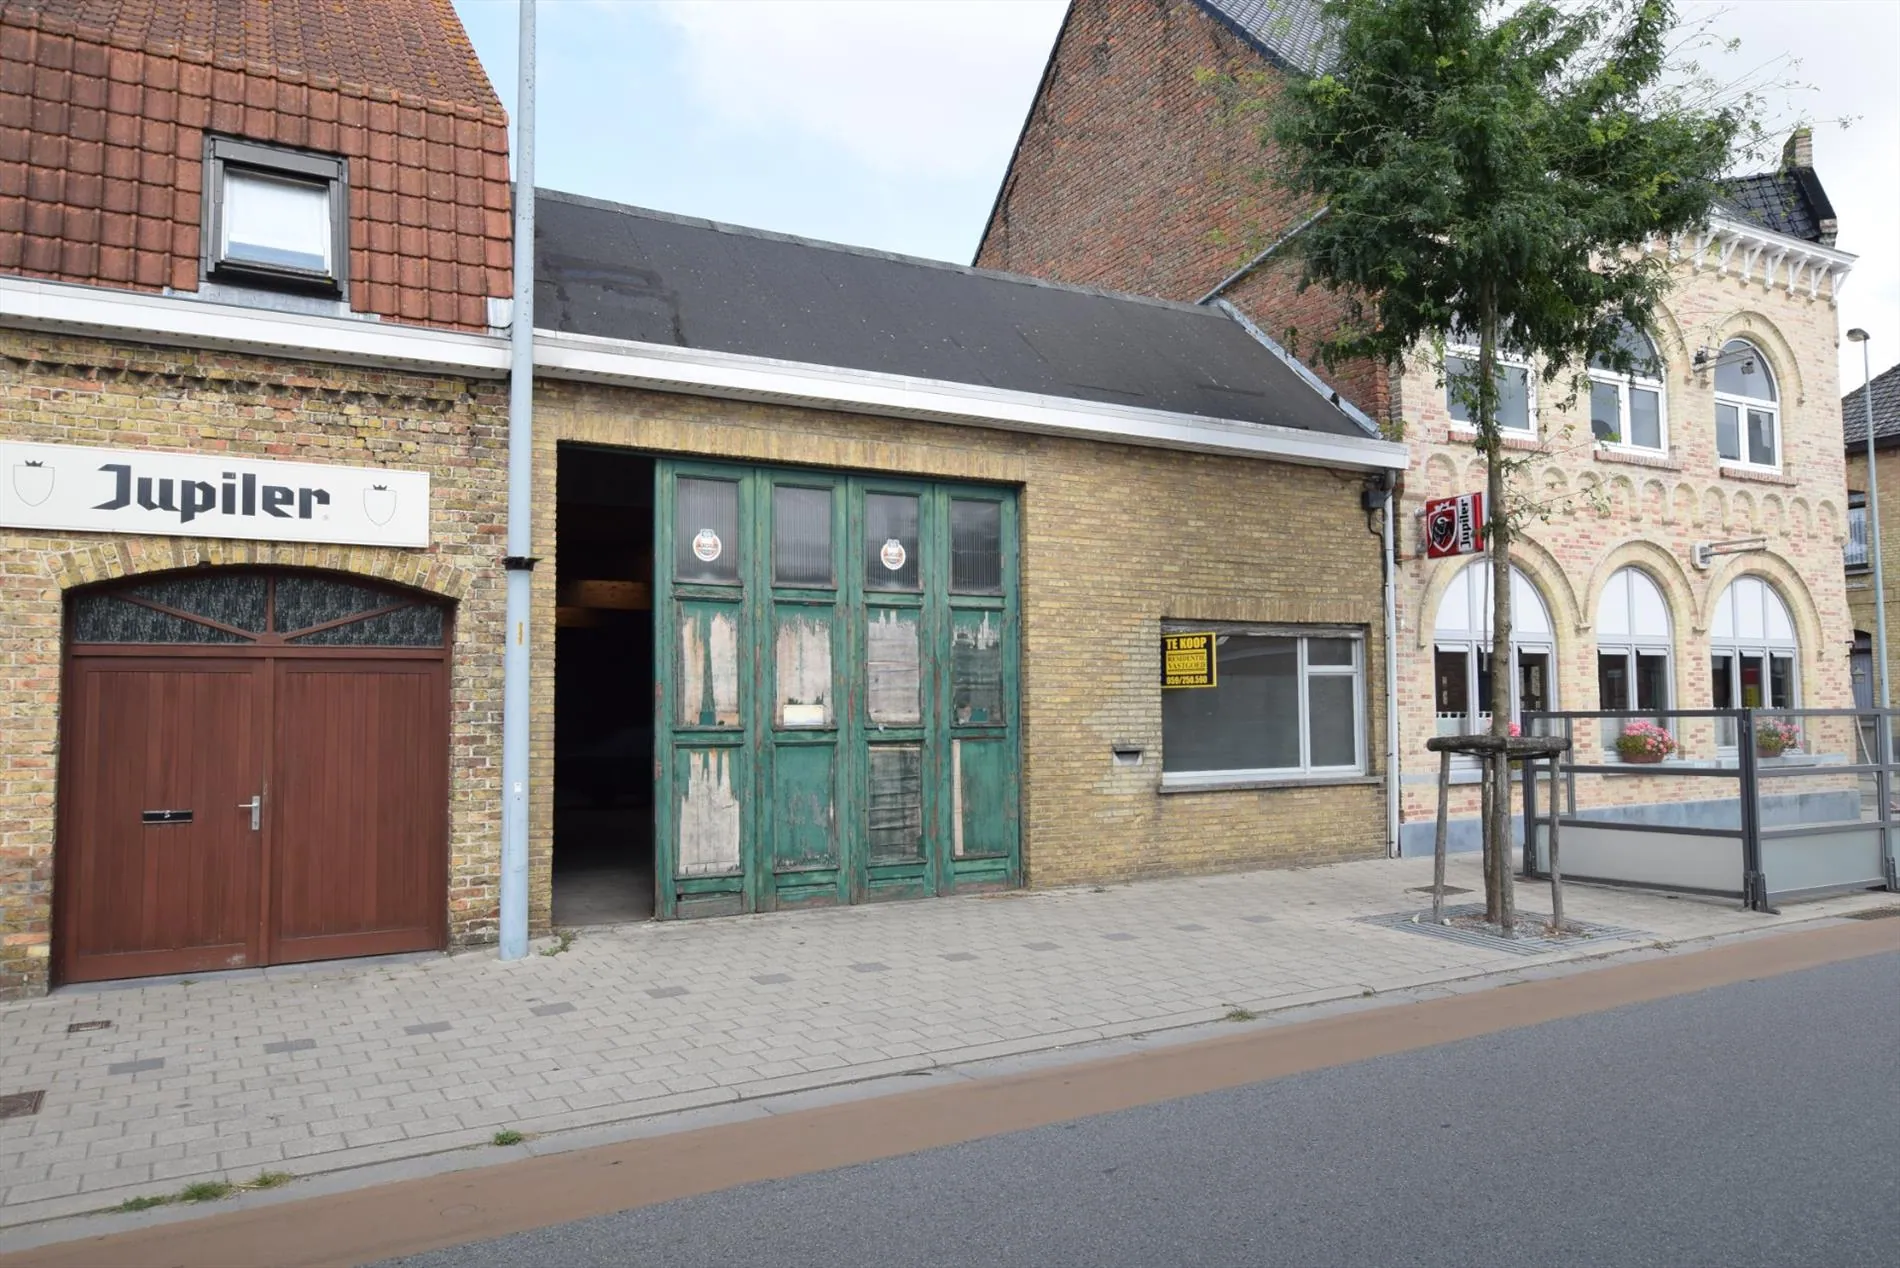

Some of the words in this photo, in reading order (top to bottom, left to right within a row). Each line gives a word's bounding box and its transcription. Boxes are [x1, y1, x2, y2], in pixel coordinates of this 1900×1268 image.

[90, 464, 330, 524] Jupiler
[1459, 498, 1471, 548] Jupiler
[1166, 638, 1178, 649] TE
[1179, 637, 1207, 649] KOOP
